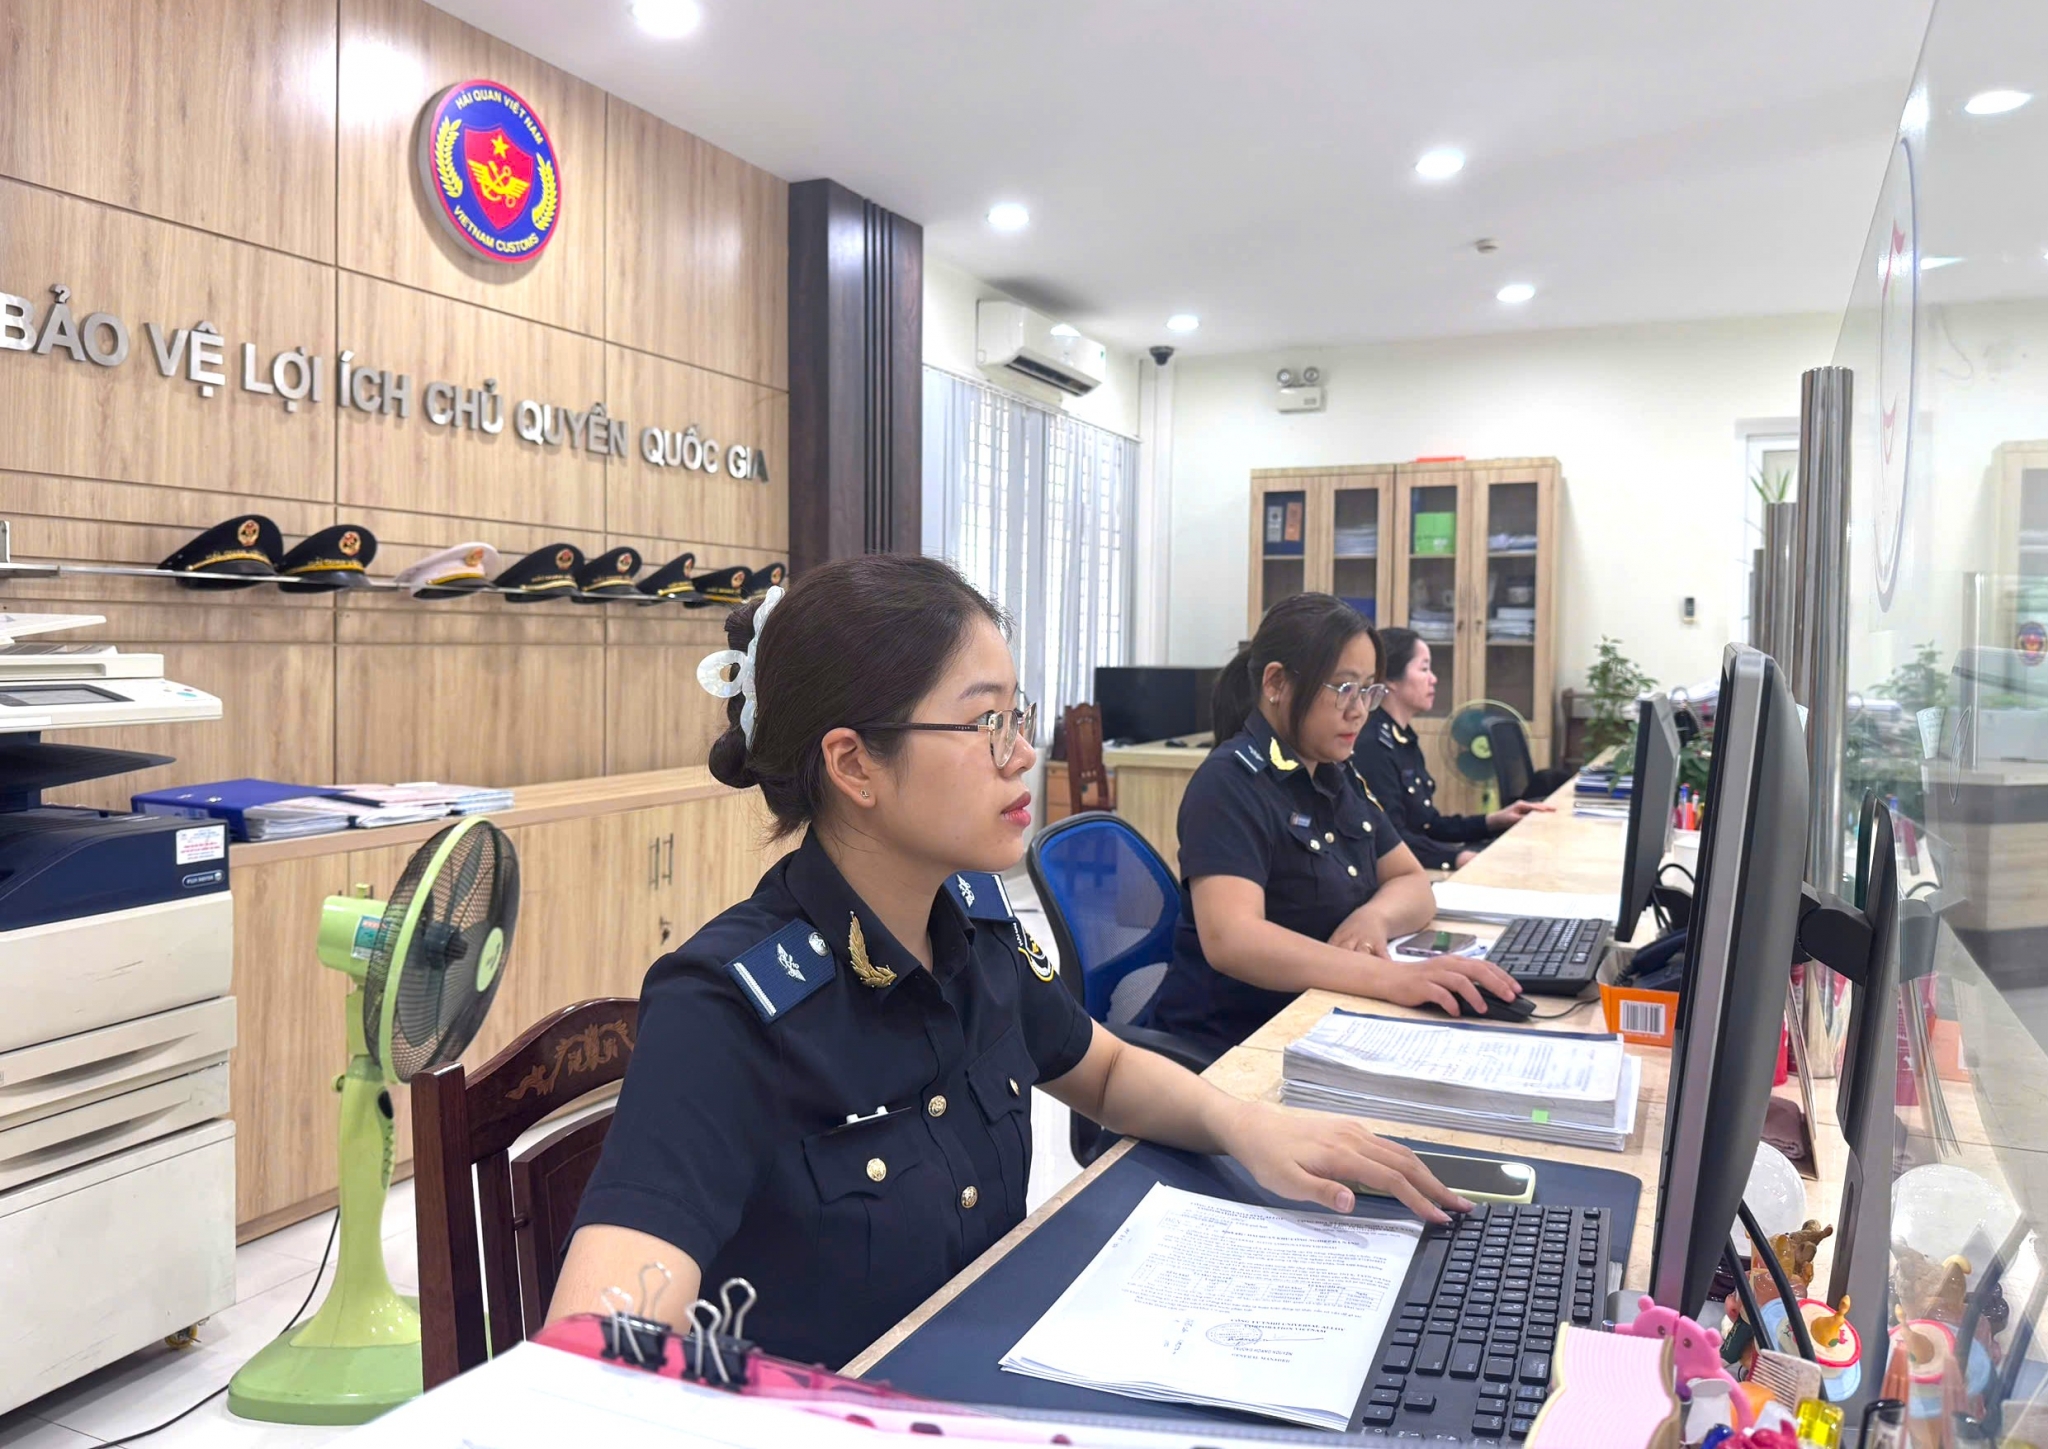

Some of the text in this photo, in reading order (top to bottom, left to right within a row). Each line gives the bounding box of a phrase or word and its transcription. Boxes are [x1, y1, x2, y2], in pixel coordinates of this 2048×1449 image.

[475, 89, 502, 103] QUAN
[523, 113, 544, 145] NAM
[453, 205, 540, 253] VIETNAM CUSTOMS
[0, 283, 769, 483] BẢO VỆ LỢI ÍCH CHỦ QUYỀN QUỐC GIA
